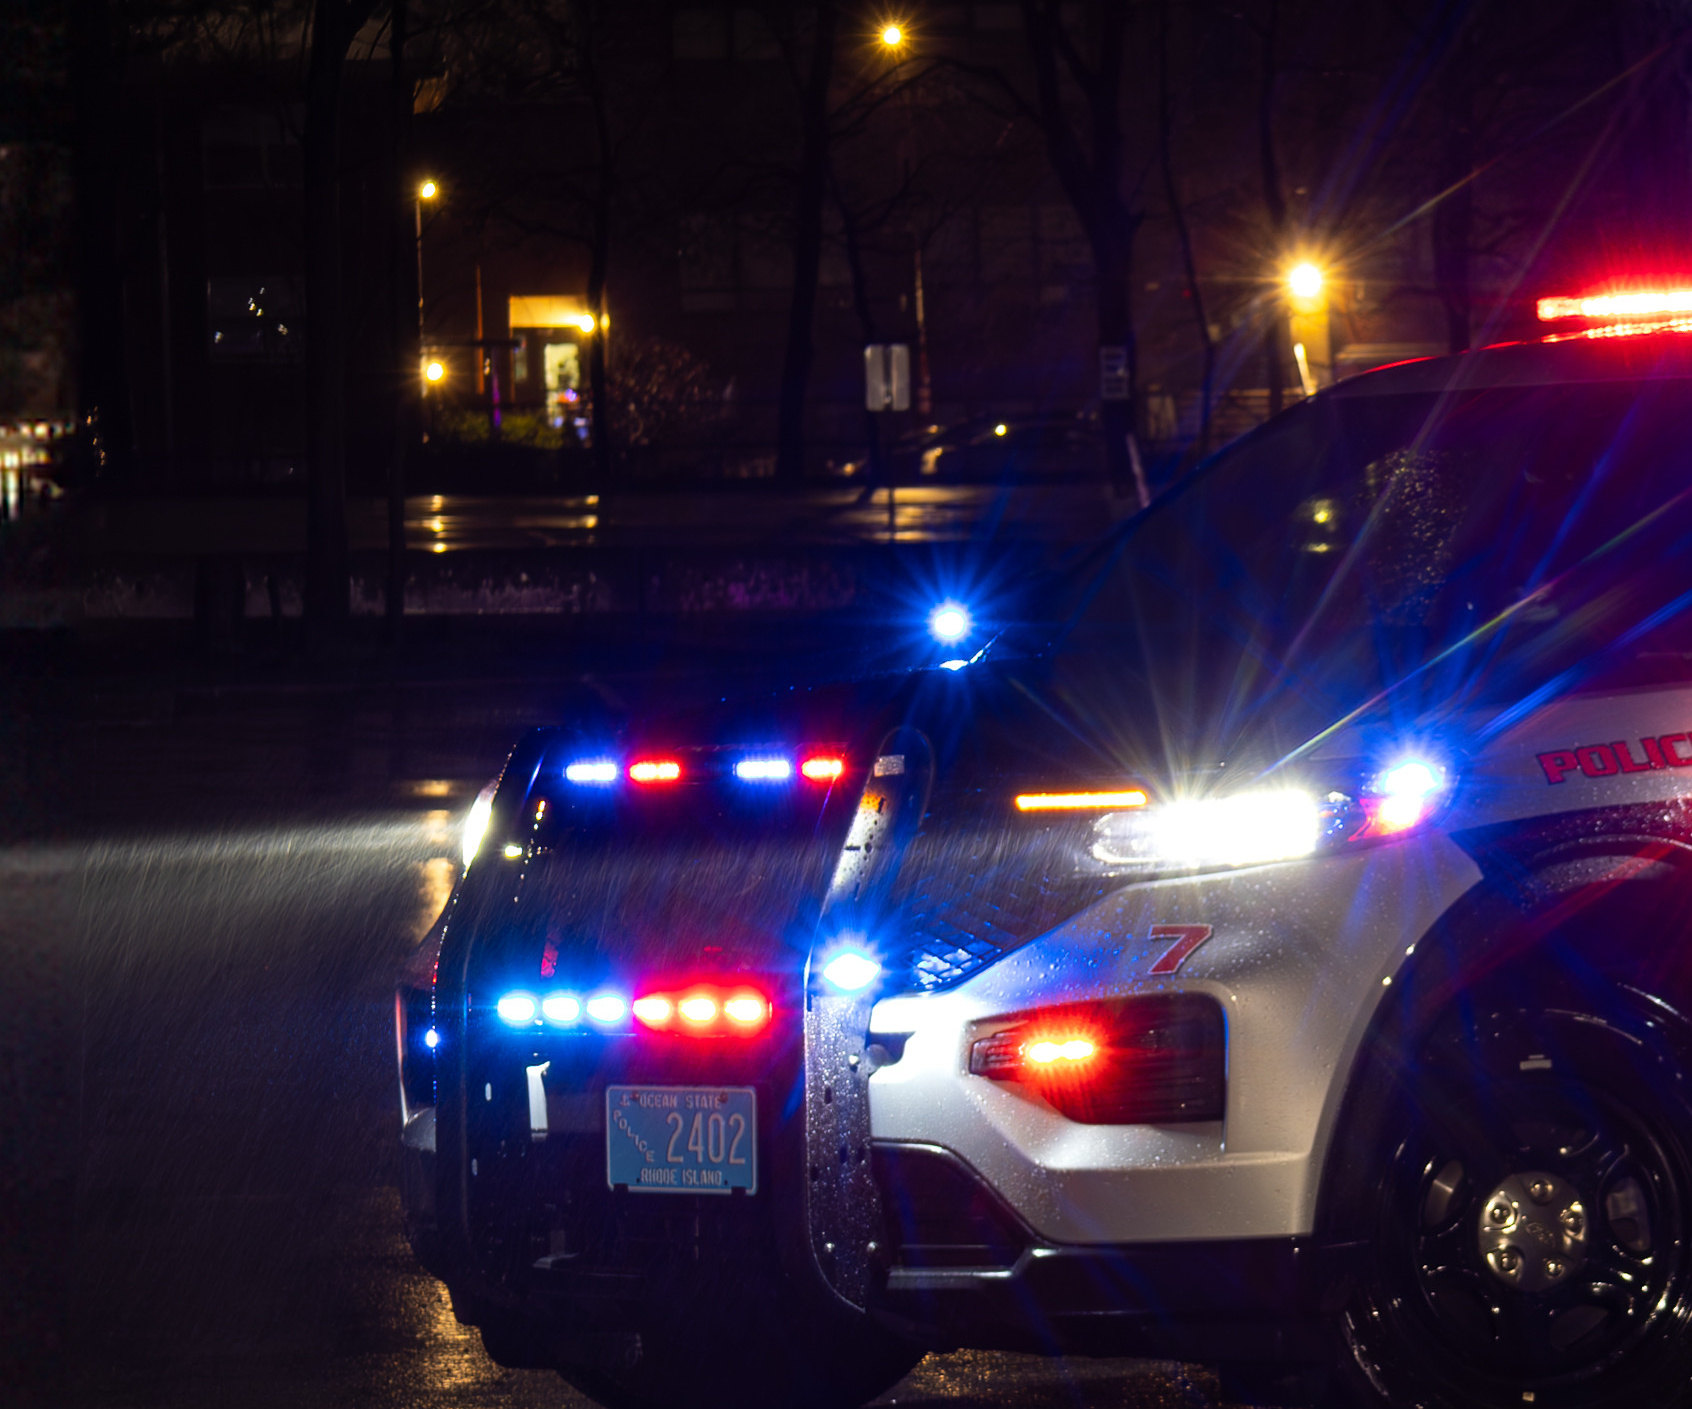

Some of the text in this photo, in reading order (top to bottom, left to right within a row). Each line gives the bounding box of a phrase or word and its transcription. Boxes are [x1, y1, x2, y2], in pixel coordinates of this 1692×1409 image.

[1148, 924, 1213, 976] 7
[639, 1094, 722, 1109] OCEAN STATE
[613, 1109, 655, 1163] POLICE
[666, 1112, 746, 1164] 2402
[641, 1168, 722, 1186] RHODE ISLAND
